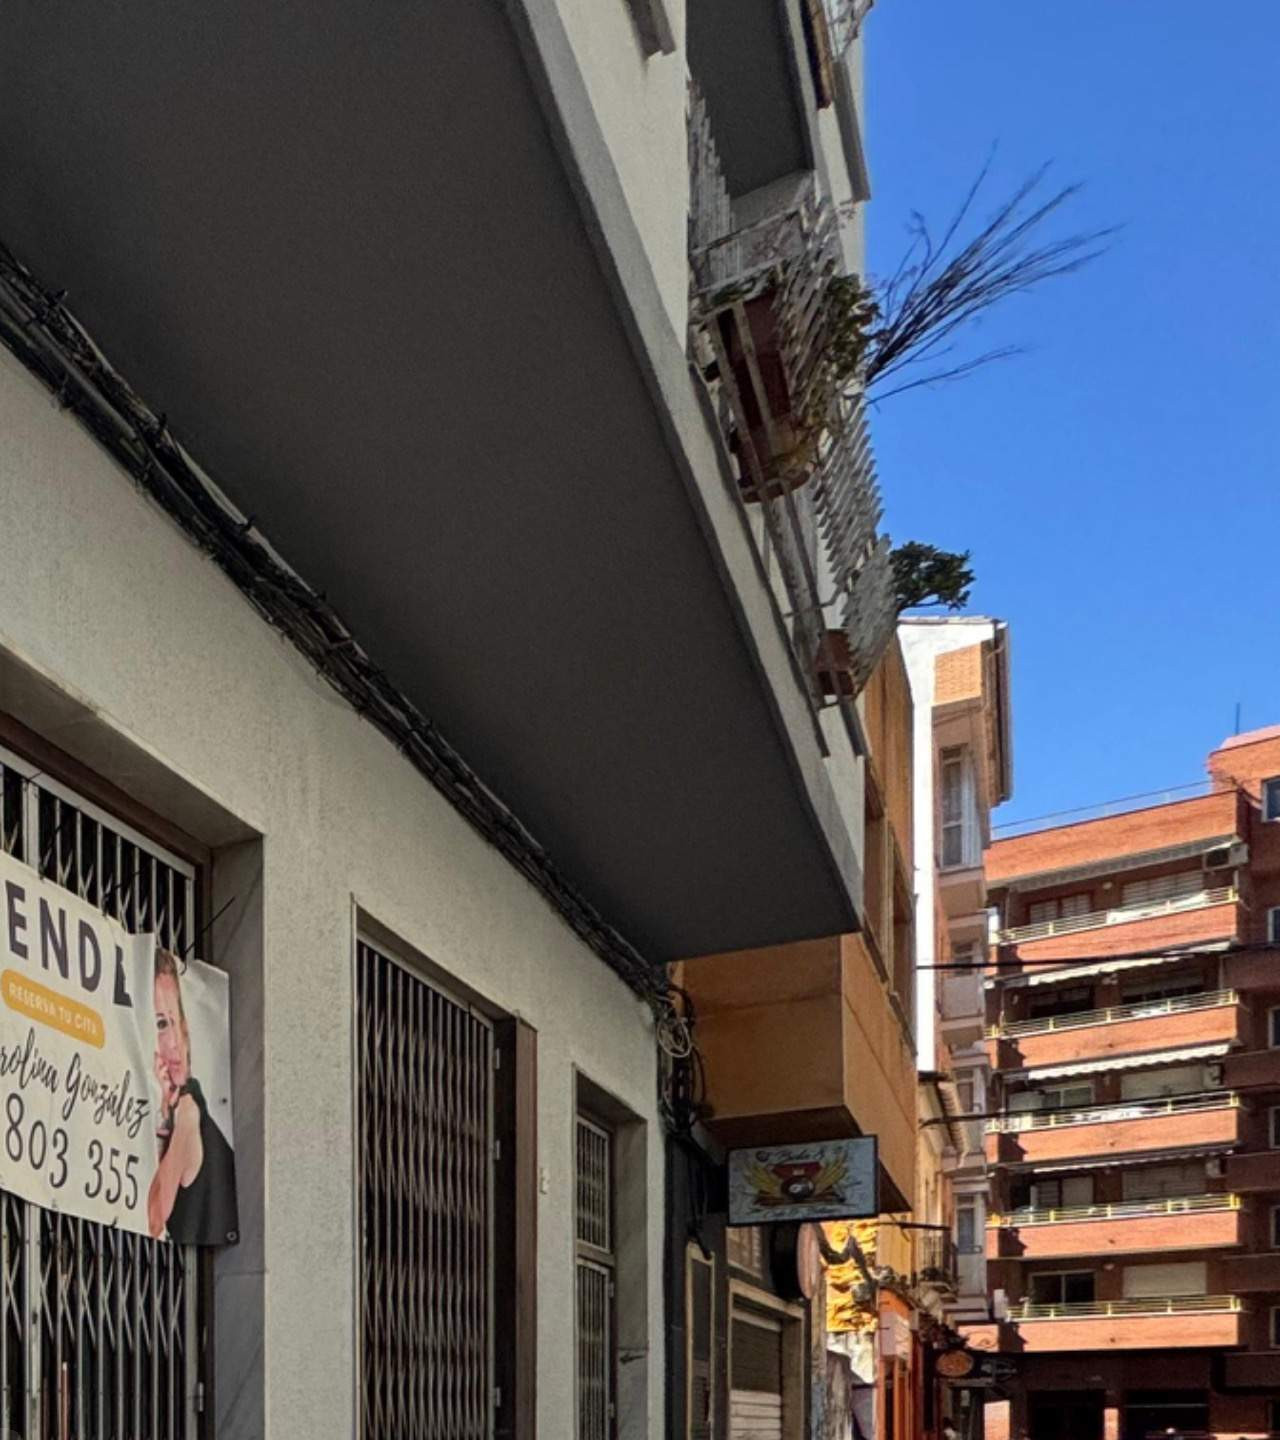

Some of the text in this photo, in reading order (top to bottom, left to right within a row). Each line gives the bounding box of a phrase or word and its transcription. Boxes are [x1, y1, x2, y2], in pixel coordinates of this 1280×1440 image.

[8, 981, 56, 1017] RESERVA
[59, 1006, 72, 1025] TU
[62, 1052, 151, 1140] González
[5, 1092, 70, 1189] 803
[85, 1139, 140, 1210] 355
